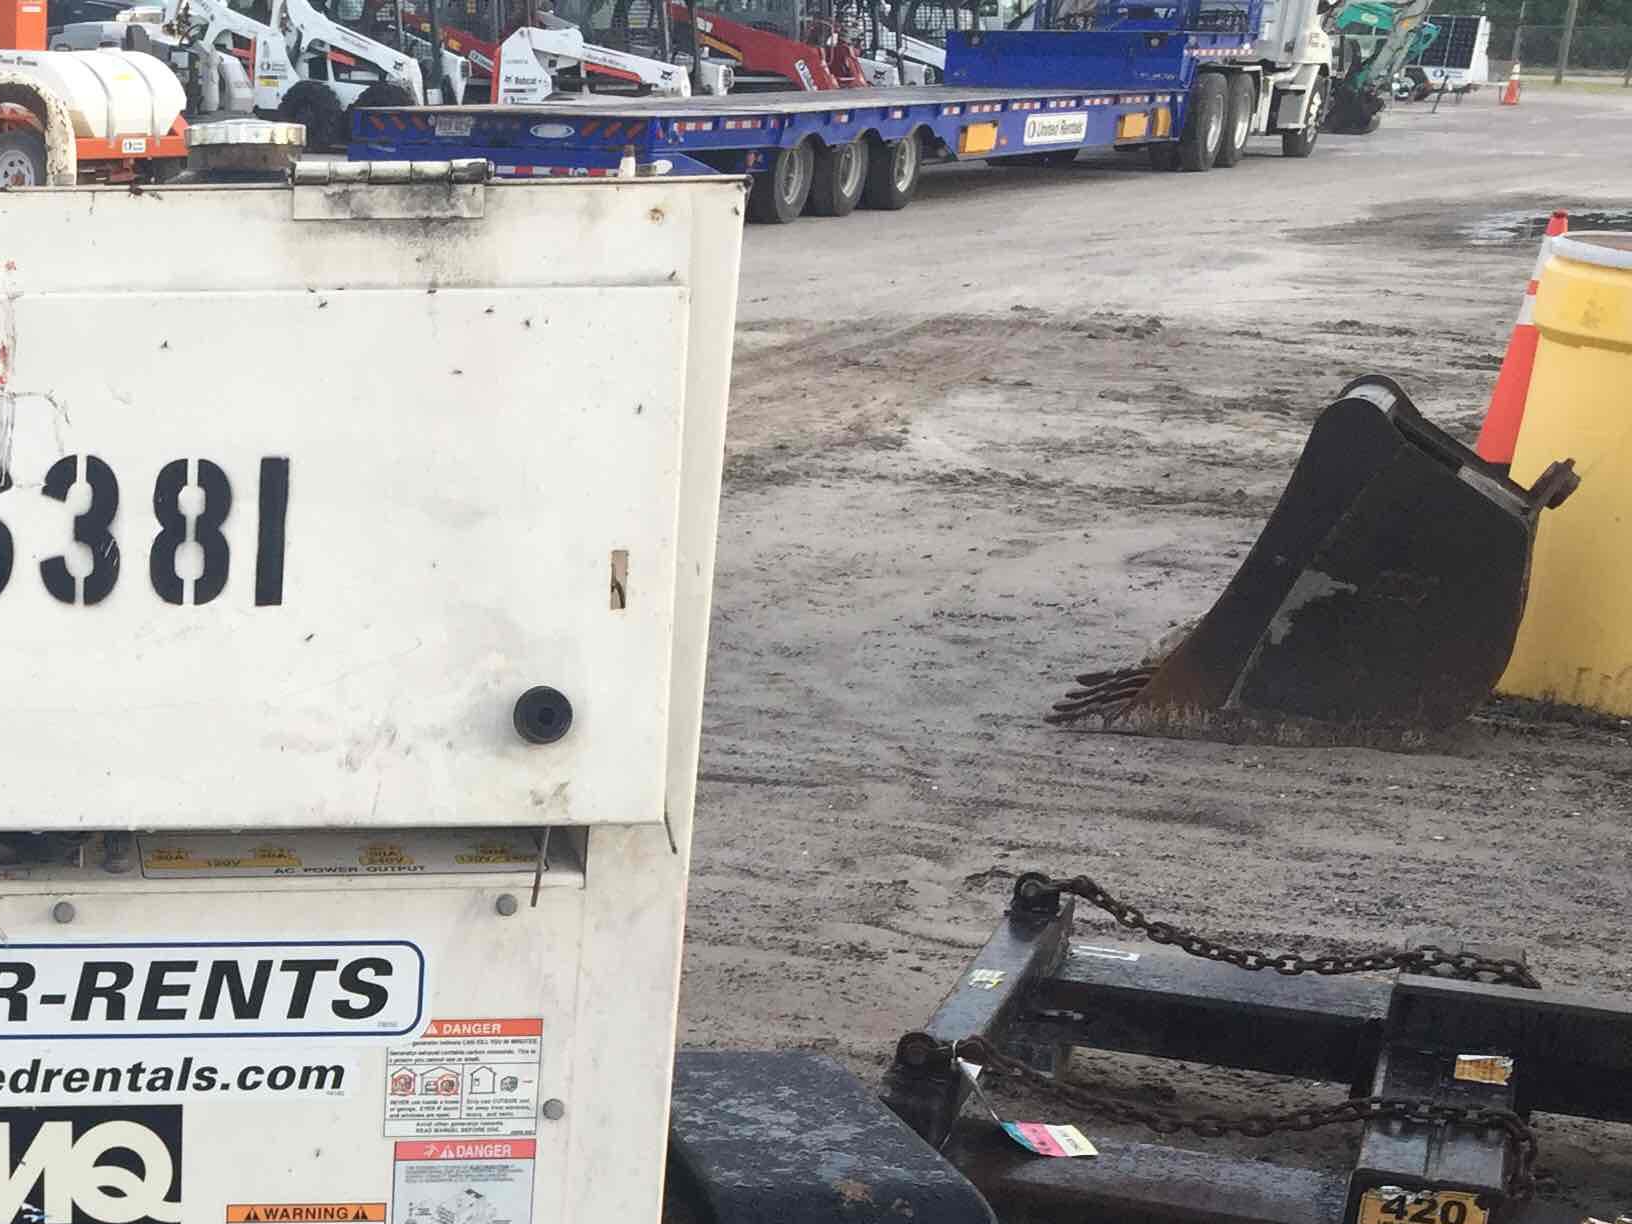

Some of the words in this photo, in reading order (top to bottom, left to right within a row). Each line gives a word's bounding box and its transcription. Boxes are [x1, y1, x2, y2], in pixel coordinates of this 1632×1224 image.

[273, 867, 296, 875] AC
[302, 865, 359, 874] POWER
[365, 864, 427, 873] OUTPUT
[442, 1023, 503, 1035] DANGER
[455, 1144, 513, 1158] DANGER
[263, 1206, 349, 1220] WARNING
